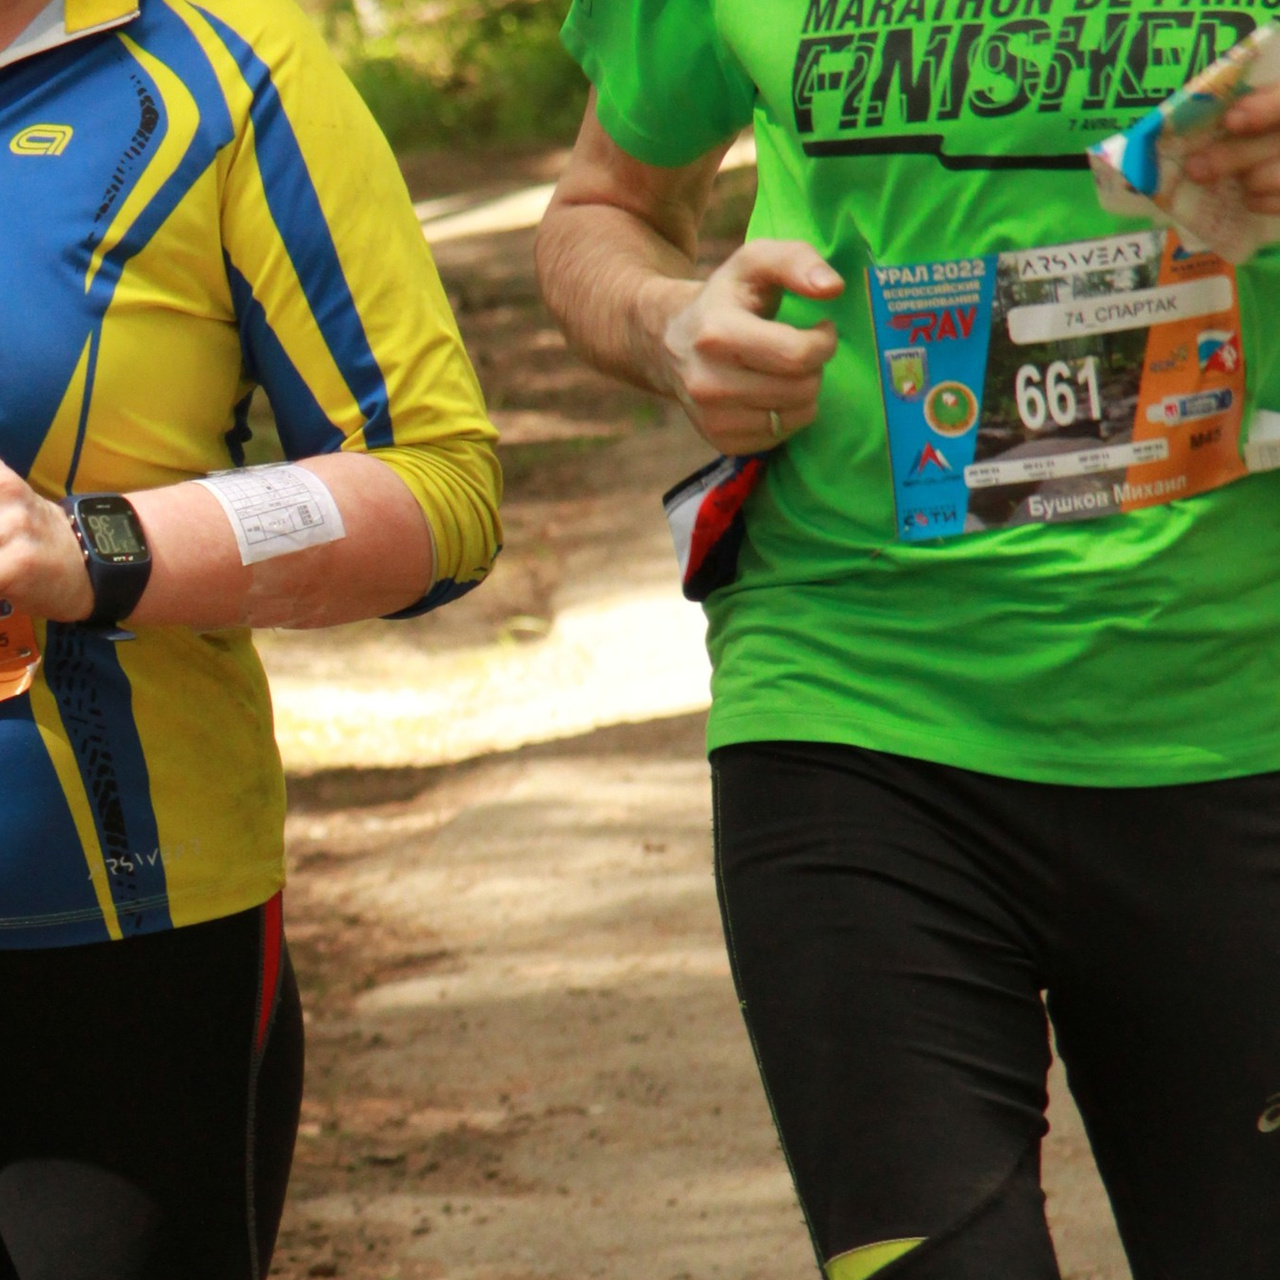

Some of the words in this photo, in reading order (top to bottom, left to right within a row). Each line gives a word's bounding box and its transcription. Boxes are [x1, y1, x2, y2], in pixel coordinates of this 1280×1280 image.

[875, 264, 929, 287] УРАЛ
[932, 258, 986, 281] 2022
[1014, 354, 1102, 431] 661
[1028, 492, 1110, 520] Бушков
[1113, 474, 1188, 504] Михаил
